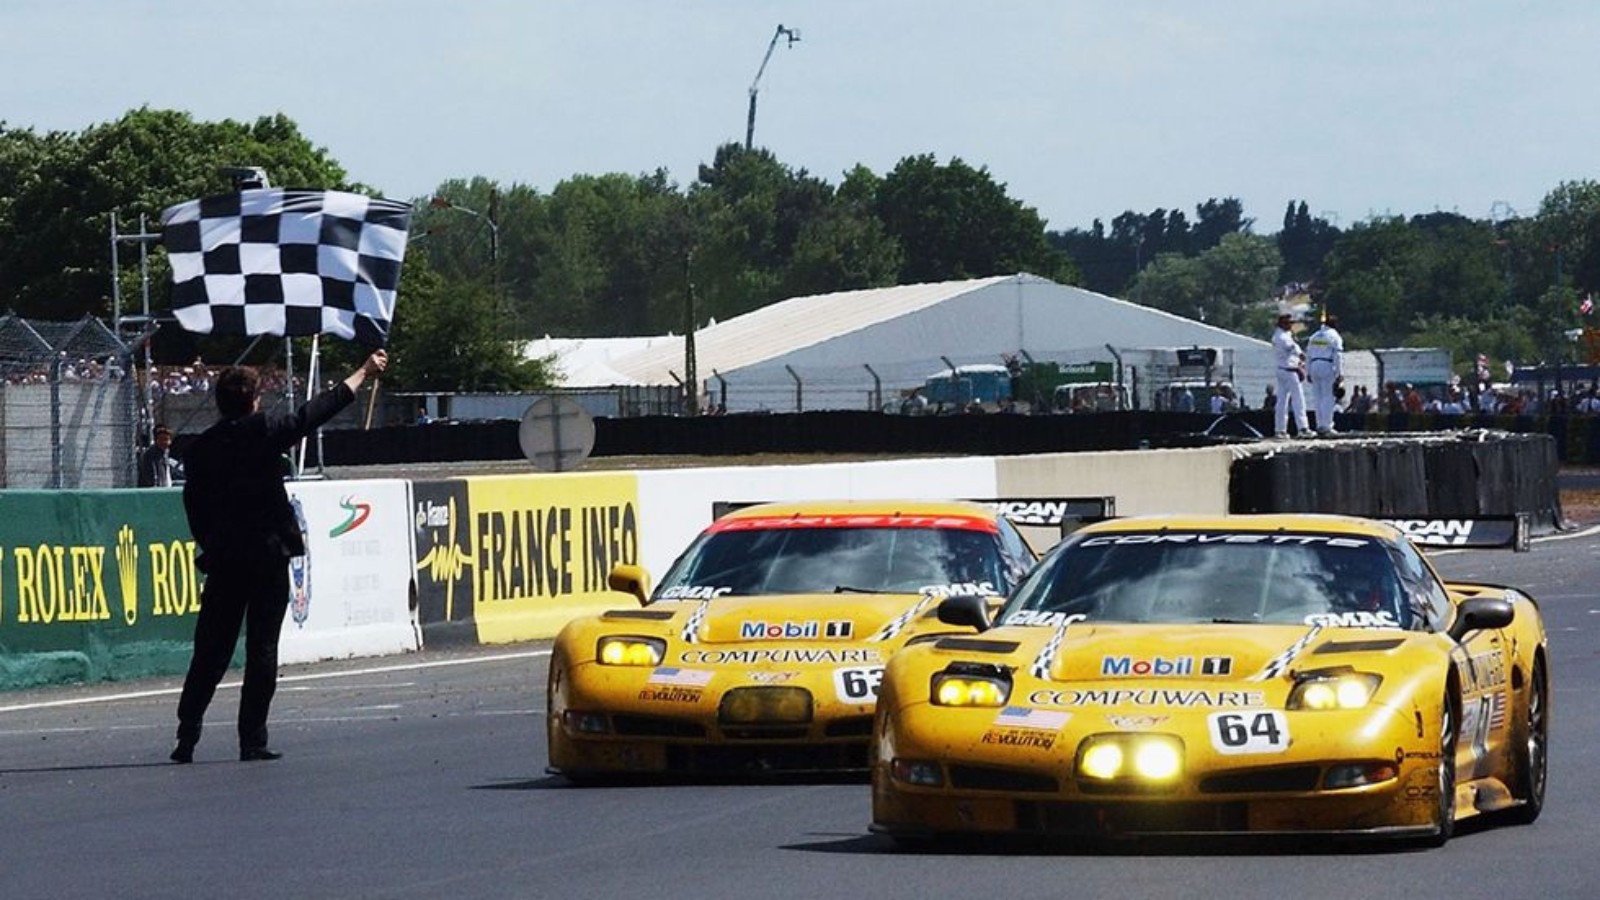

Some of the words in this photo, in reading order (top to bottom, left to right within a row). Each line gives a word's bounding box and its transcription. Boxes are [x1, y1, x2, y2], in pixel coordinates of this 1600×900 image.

[994, 502, 1068, 517] ICAN
[1392, 520, 1474, 535] ICAN
[1080, 533, 1371, 547] CORVETTE
[477, 506, 572, 601] FRANCE
[582, 502, 638, 594] INFO
[14, 543, 111, 624] ROLEX
[149, 540, 202, 617] ROL
[661, 585, 732, 599] GMAC
[919, 583, 999, 597] GMAC
[1006, 610, 1087, 626] GMAC
[1304, 611, 1400, 628] GMAC
[741, 622, 817, 638] Mobil
[680, 649, 878, 664] COMPUWARE
[1103, 656, 1193, 675] Mobil
[842, 670, 884, 699] 63
[1029, 690, 1265, 706] COMPUWARE
[1217, 712, 1281, 746] 64
